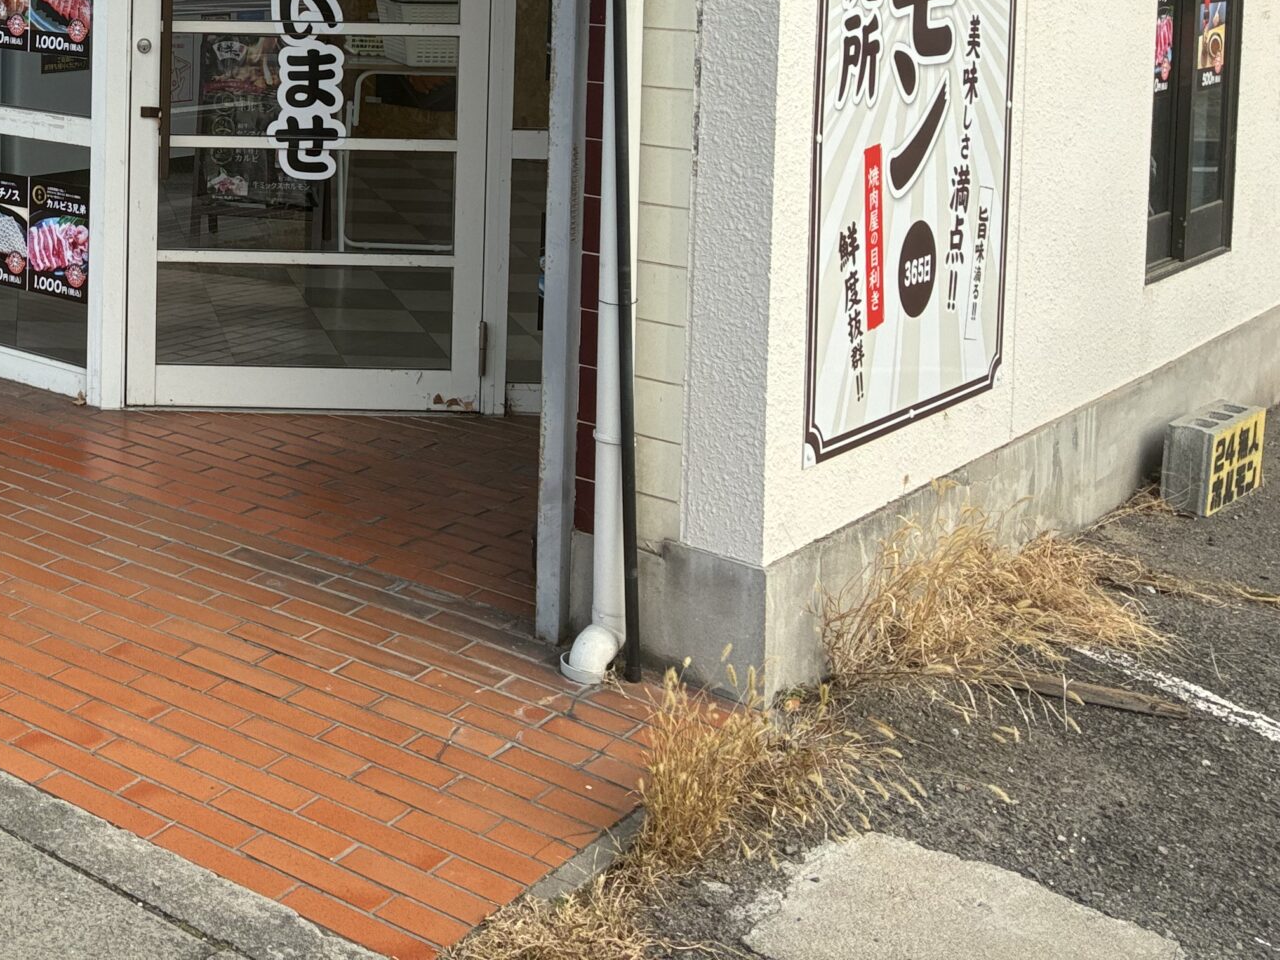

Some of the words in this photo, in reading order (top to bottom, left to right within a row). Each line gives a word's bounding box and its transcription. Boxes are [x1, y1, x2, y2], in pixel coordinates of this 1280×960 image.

[867, 165, 880, 312] 焼肉屋の目利き
[904, 255, 931, 288] 365日
